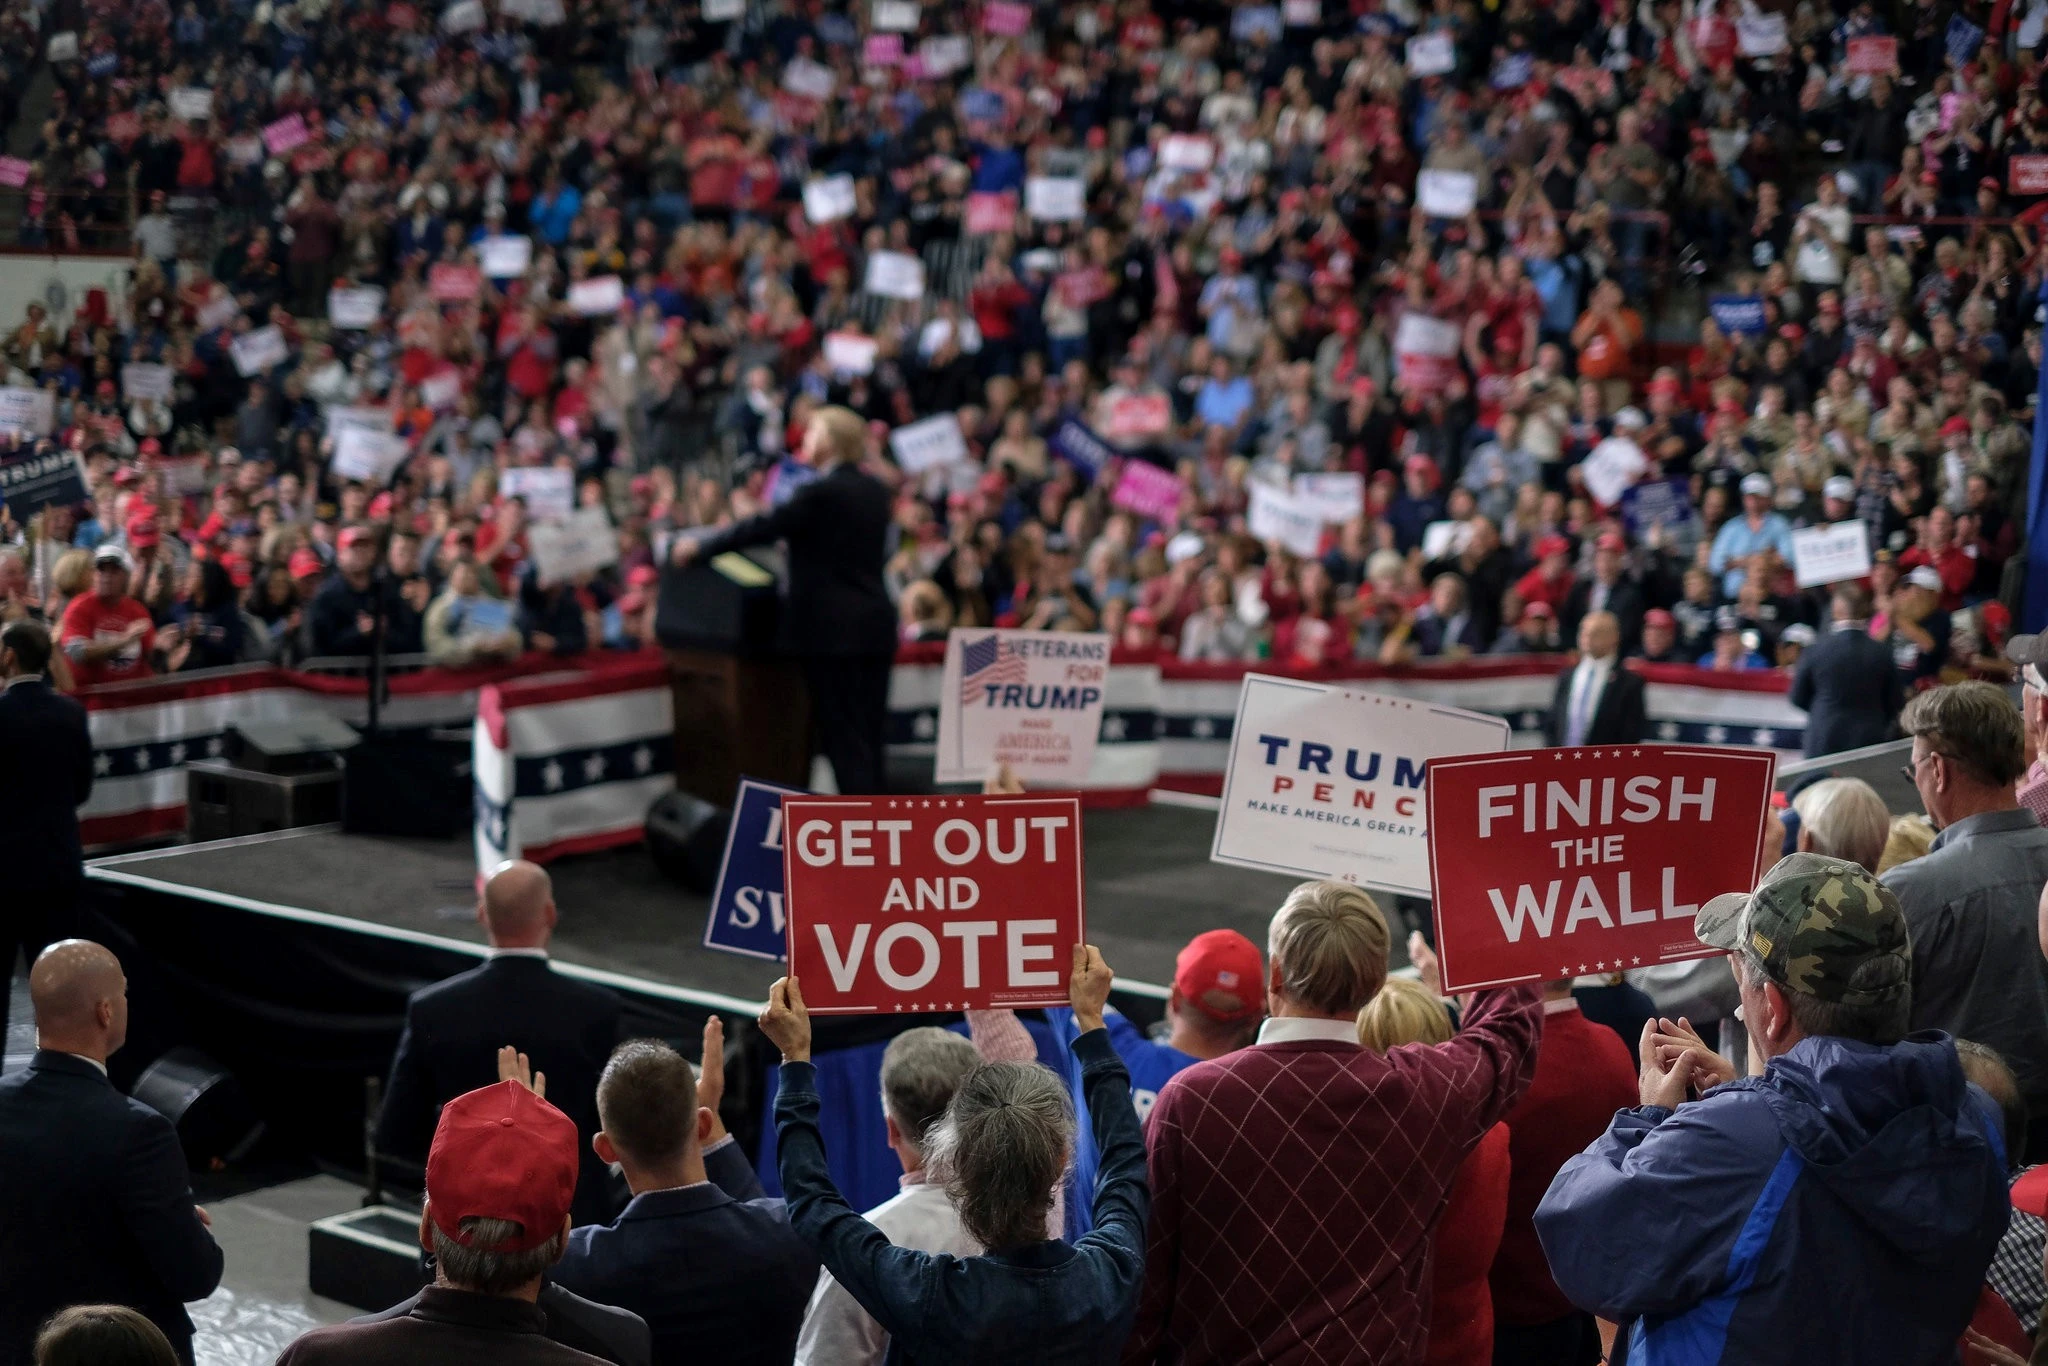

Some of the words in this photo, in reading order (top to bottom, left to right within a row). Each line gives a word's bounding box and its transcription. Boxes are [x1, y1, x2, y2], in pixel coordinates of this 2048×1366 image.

[1007, 638, 1104, 660] VETERANS
[1066, 664, 1103, 681] FOR
[985, 683, 1100, 709] TRUMP
[1259, 733, 1427, 790] TRUM
[1273, 775, 1416, 816] PENC
[1479, 775, 1717, 838] FINISH
[1247, 799, 1289, 816] MAKE
[1294, 807, 1361, 827] AMERICA
[1367, 821, 1416, 837] GREAT
[796, 818, 912, 868] GET
[933, 816, 1069, 866] OUT
[1551, 834, 1625, 868] THE
[880, 877, 980, 912] AND
[1487, 866, 1699, 943] WALL
[813, 918, 1060, 993] VOTE
